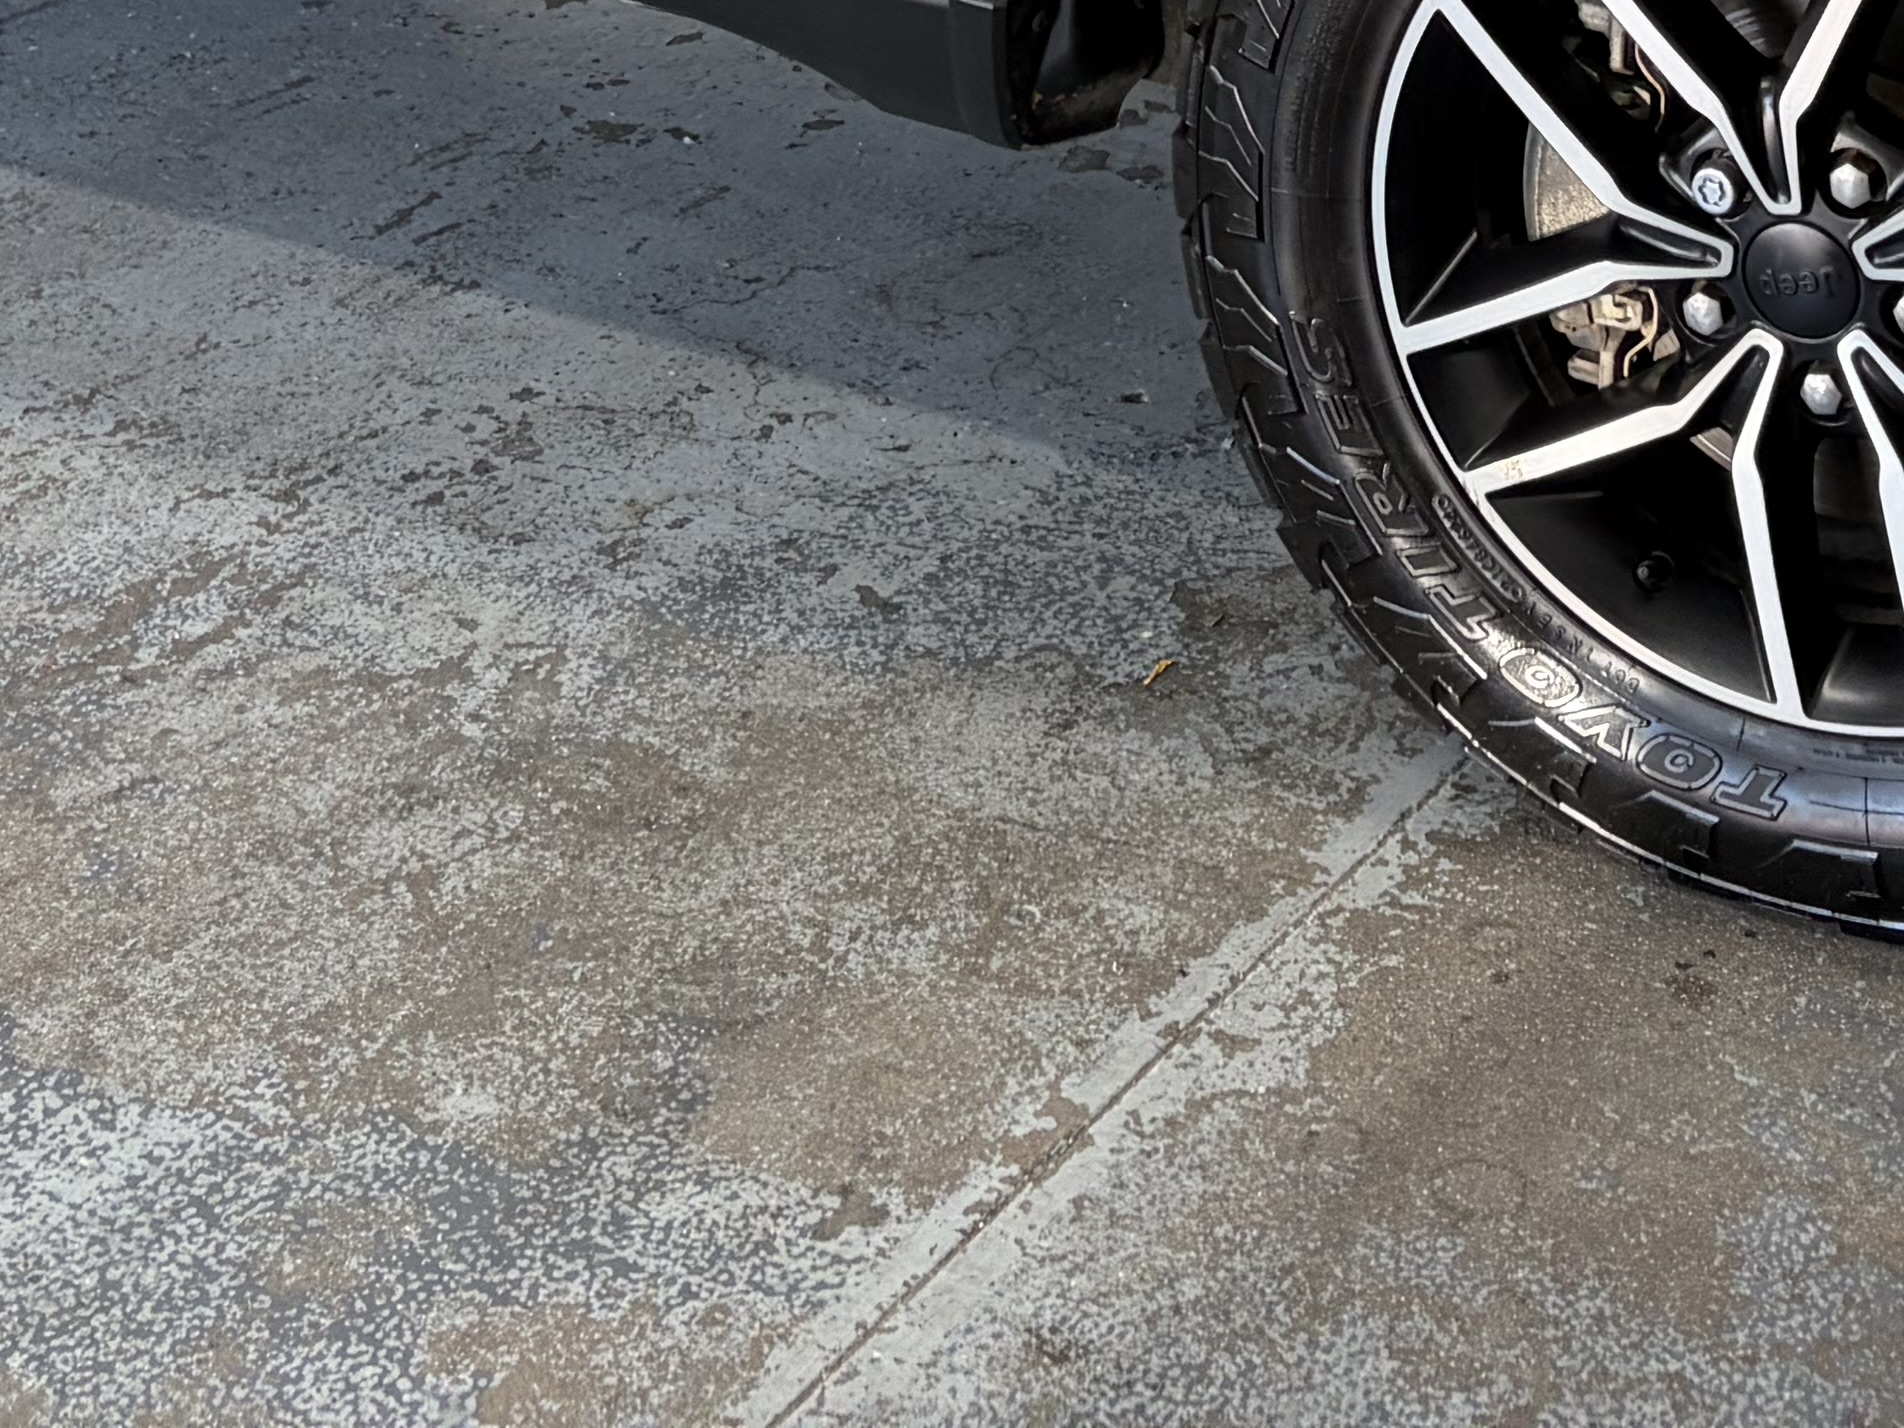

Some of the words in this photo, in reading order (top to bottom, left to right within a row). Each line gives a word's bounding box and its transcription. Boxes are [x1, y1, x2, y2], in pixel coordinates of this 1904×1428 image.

[1759, 264, 1836, 298] Jeep
[1287, 309, 1504, 642] TIRES
[1497, 646, 1789, 820] TOYO
